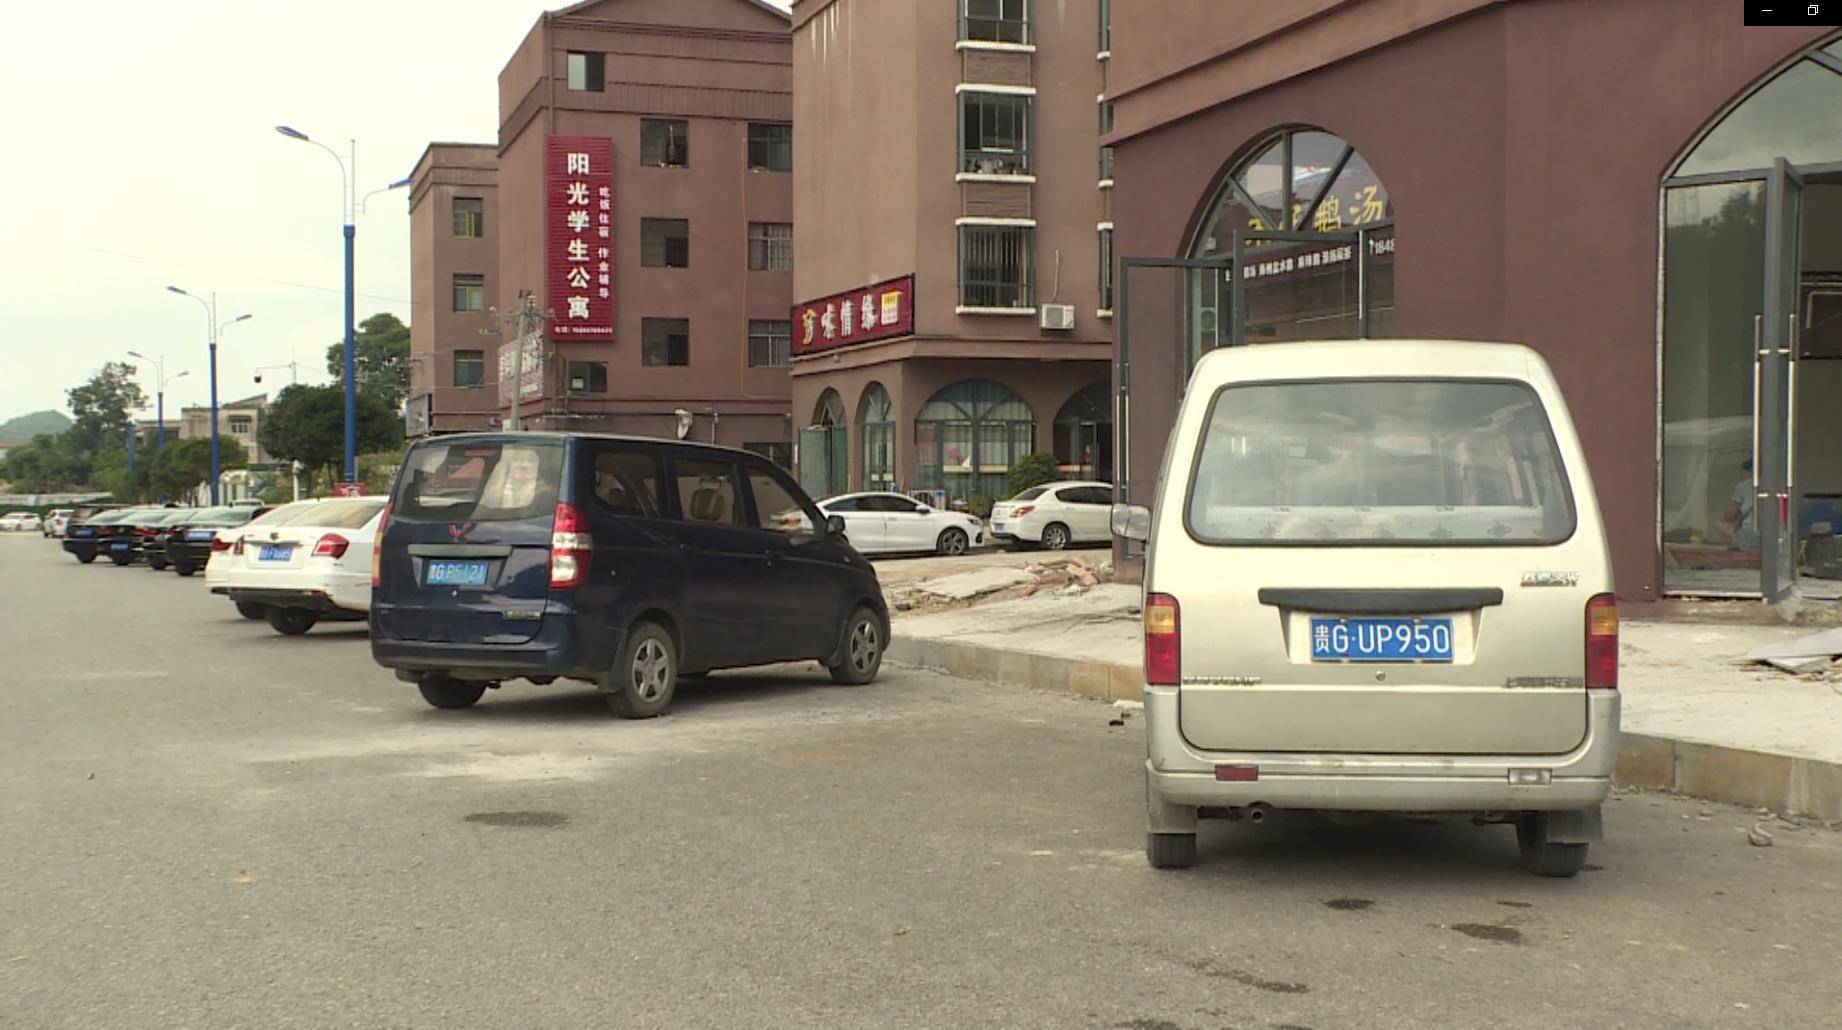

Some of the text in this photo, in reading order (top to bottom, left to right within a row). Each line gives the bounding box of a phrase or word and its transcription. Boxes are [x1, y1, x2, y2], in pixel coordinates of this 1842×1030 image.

[566, 153, 590, 319] 阳光学生公寓
